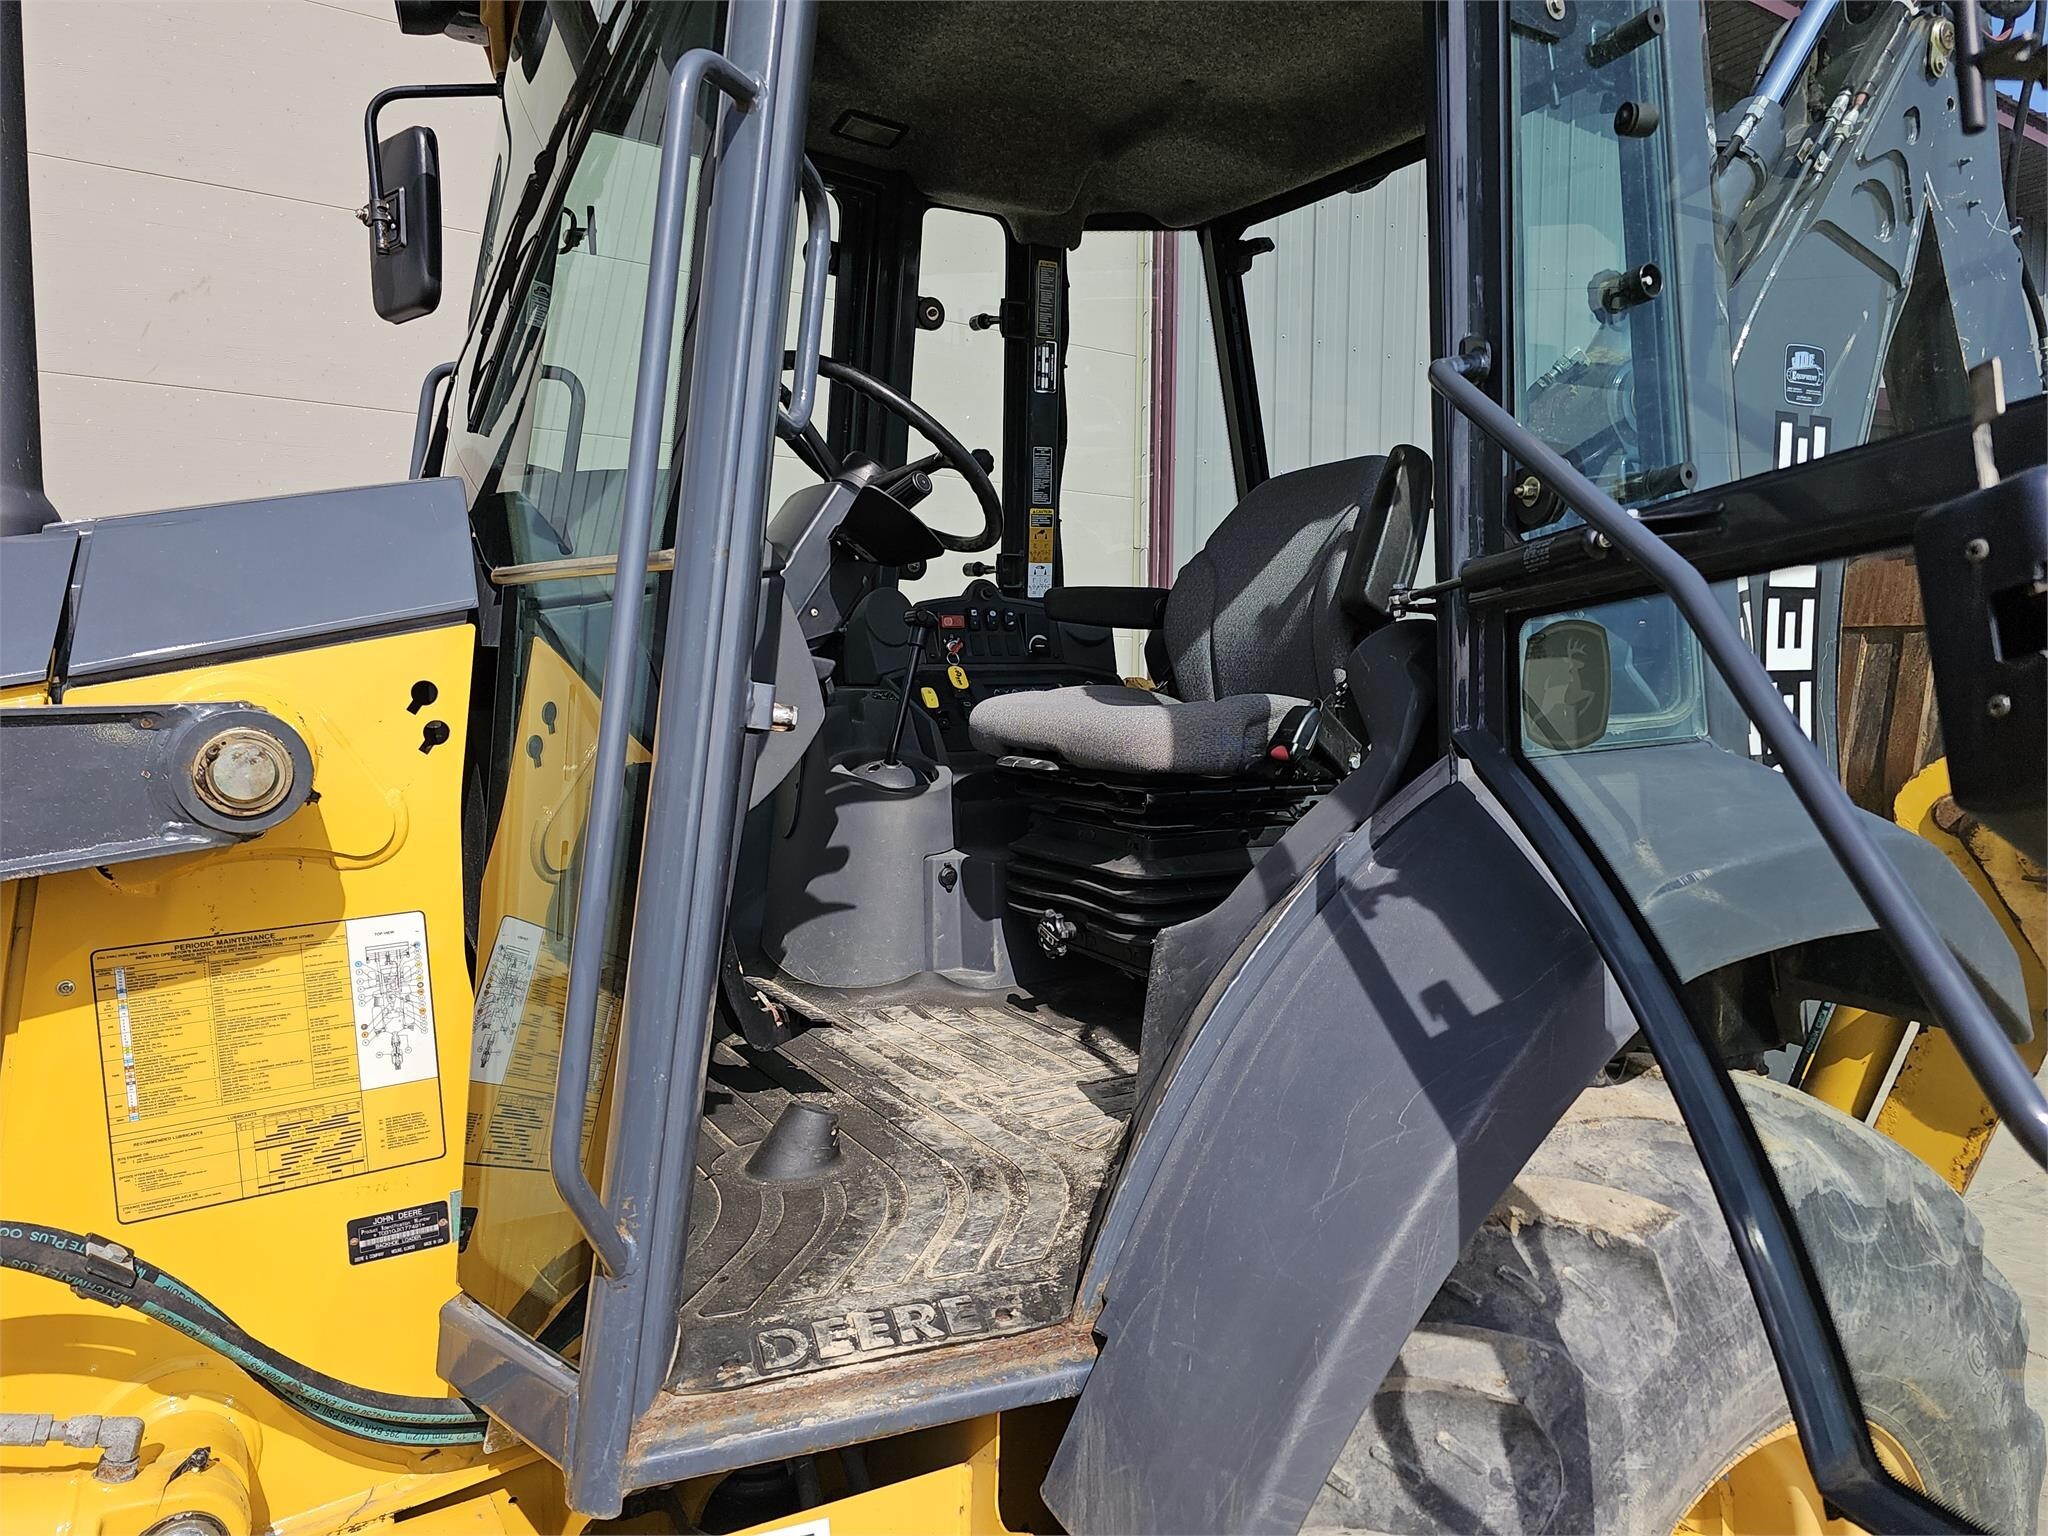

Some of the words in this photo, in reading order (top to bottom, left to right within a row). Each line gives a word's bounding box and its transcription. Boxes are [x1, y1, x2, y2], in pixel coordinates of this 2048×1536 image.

[174, 940, 215, 951] PERIODIC
[216, 933, 275, 945] MAINTENANCE
[373, 1215, 394, 1225] JOHN
[398, 1208, 422, 1219] DEERE
[755, 1294, 984, 1372] DEERE
